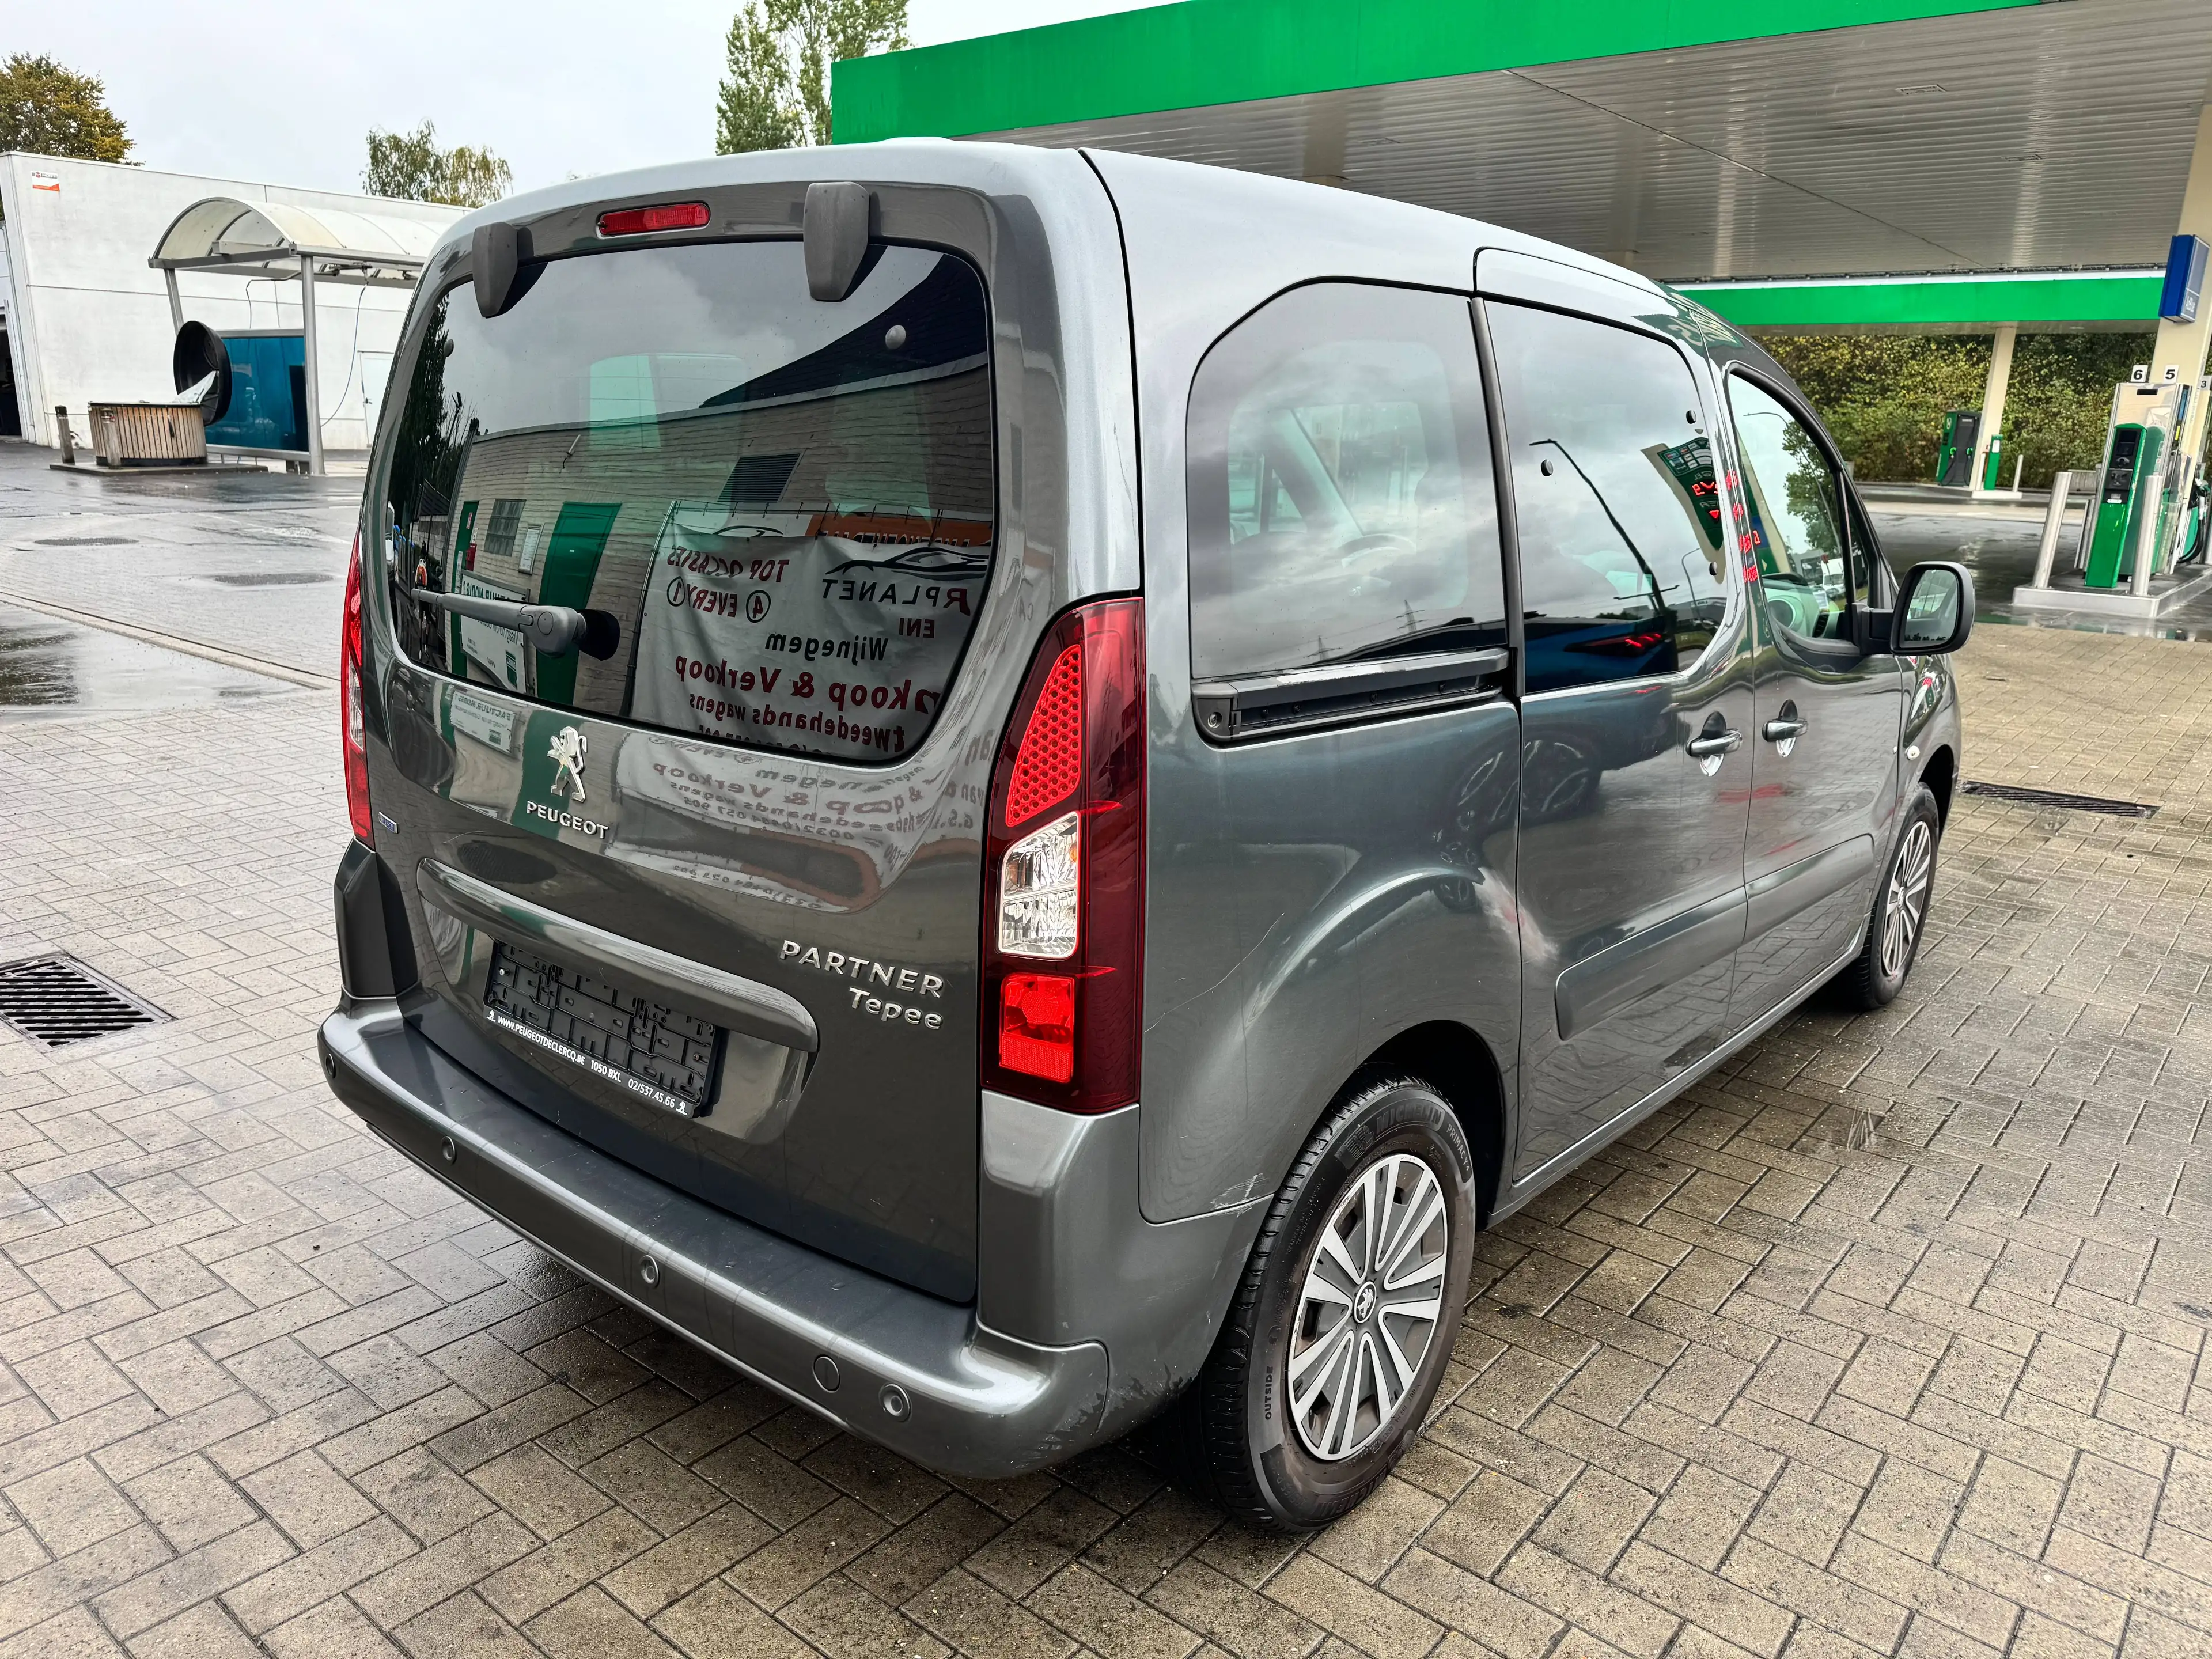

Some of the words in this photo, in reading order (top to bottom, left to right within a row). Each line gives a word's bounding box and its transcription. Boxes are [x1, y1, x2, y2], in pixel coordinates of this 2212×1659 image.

[2133, 369, 2143, 380] 6
[2165, 369, 2176, 380] 5
[2200, 380, 2208, 388] 3
[527, 801, 609, 839] PEUGEOT
[779, 940, 944, 998] PARTNER
[849, 987, 943, 1029] Tepee
[498, 1016, 585, 1065] WWW.PEUGEOTDECLERCQ.BE
[590, 1060, 607, 1075] 1050
[608, 1067, 621, 1082] BXL
[628, 1078, 675, 1109] 02/537.45.66
[1446, 1123, 1468, 1166] PRIMACY
[1264, 1366, 1274, 1420] OUTSIDE
